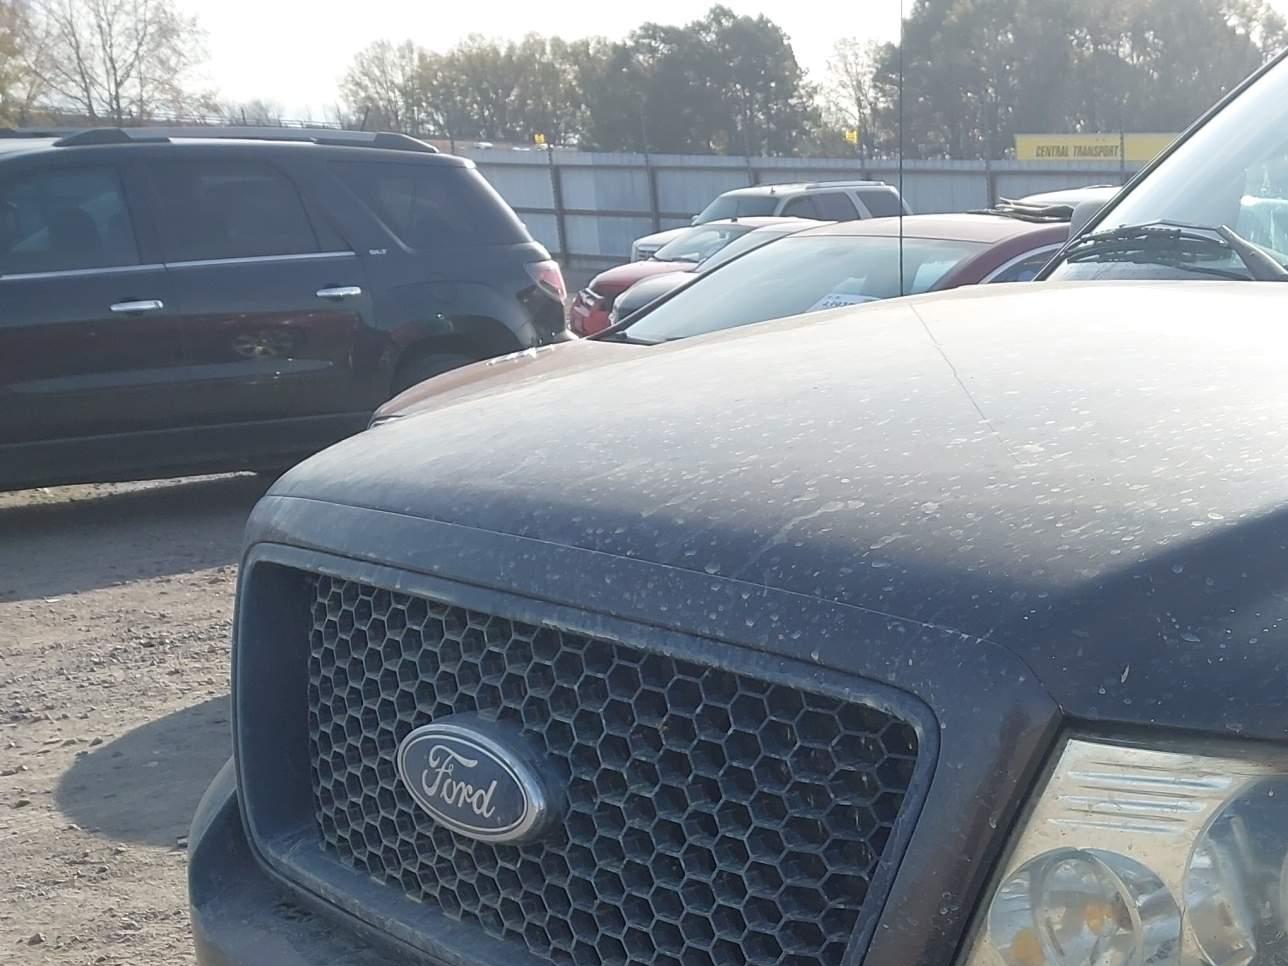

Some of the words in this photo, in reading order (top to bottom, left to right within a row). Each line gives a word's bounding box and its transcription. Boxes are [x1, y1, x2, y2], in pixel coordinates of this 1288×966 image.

[1035, 145, 1069, 158] CENTRAL
[1073, 145, 1119, 158] TRANSPORT
[422, 745, 498, 818] Ford
